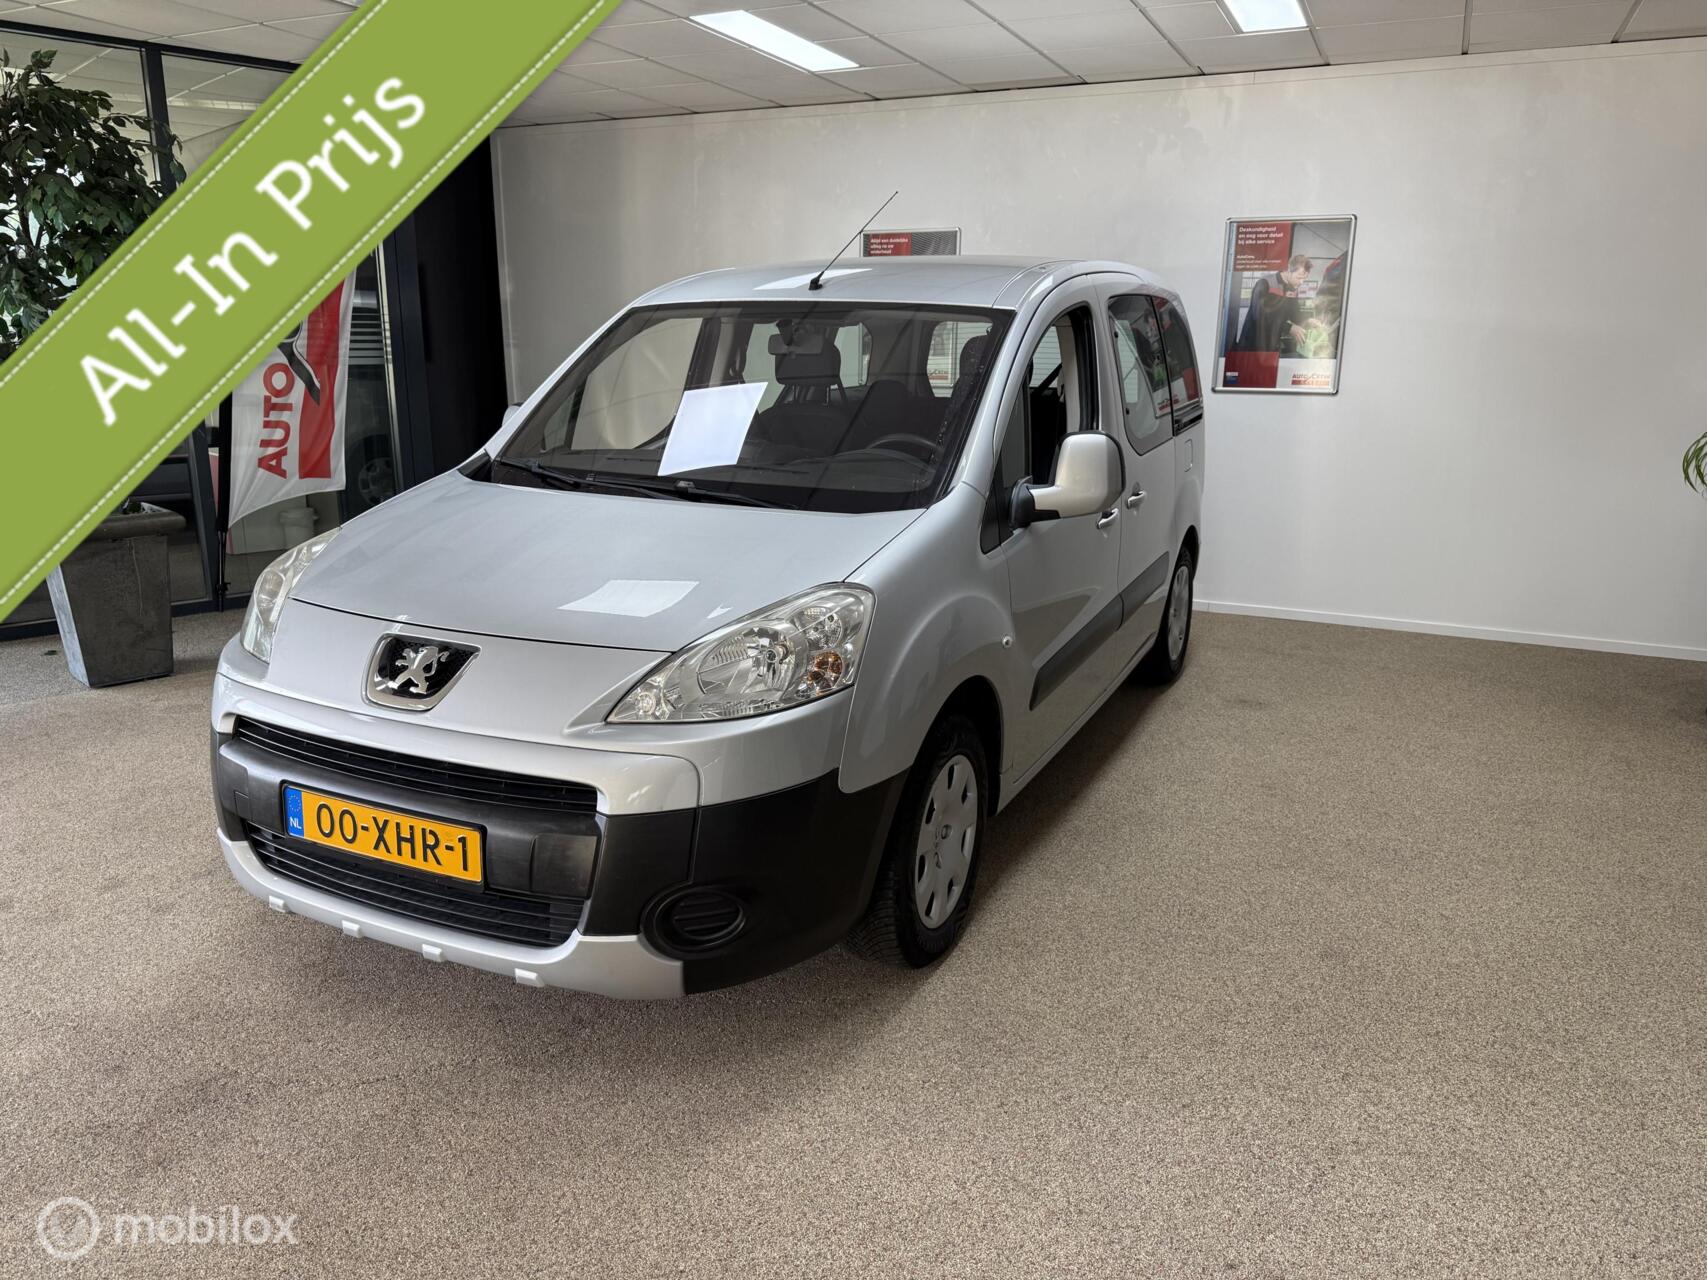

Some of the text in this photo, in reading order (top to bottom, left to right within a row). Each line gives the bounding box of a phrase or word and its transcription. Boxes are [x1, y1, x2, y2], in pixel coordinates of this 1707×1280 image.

[257, 362, 296, 479] AUTO
[289, 816, 302, 830] NL
[316, 802, 469, 872] 00-XHR-1
